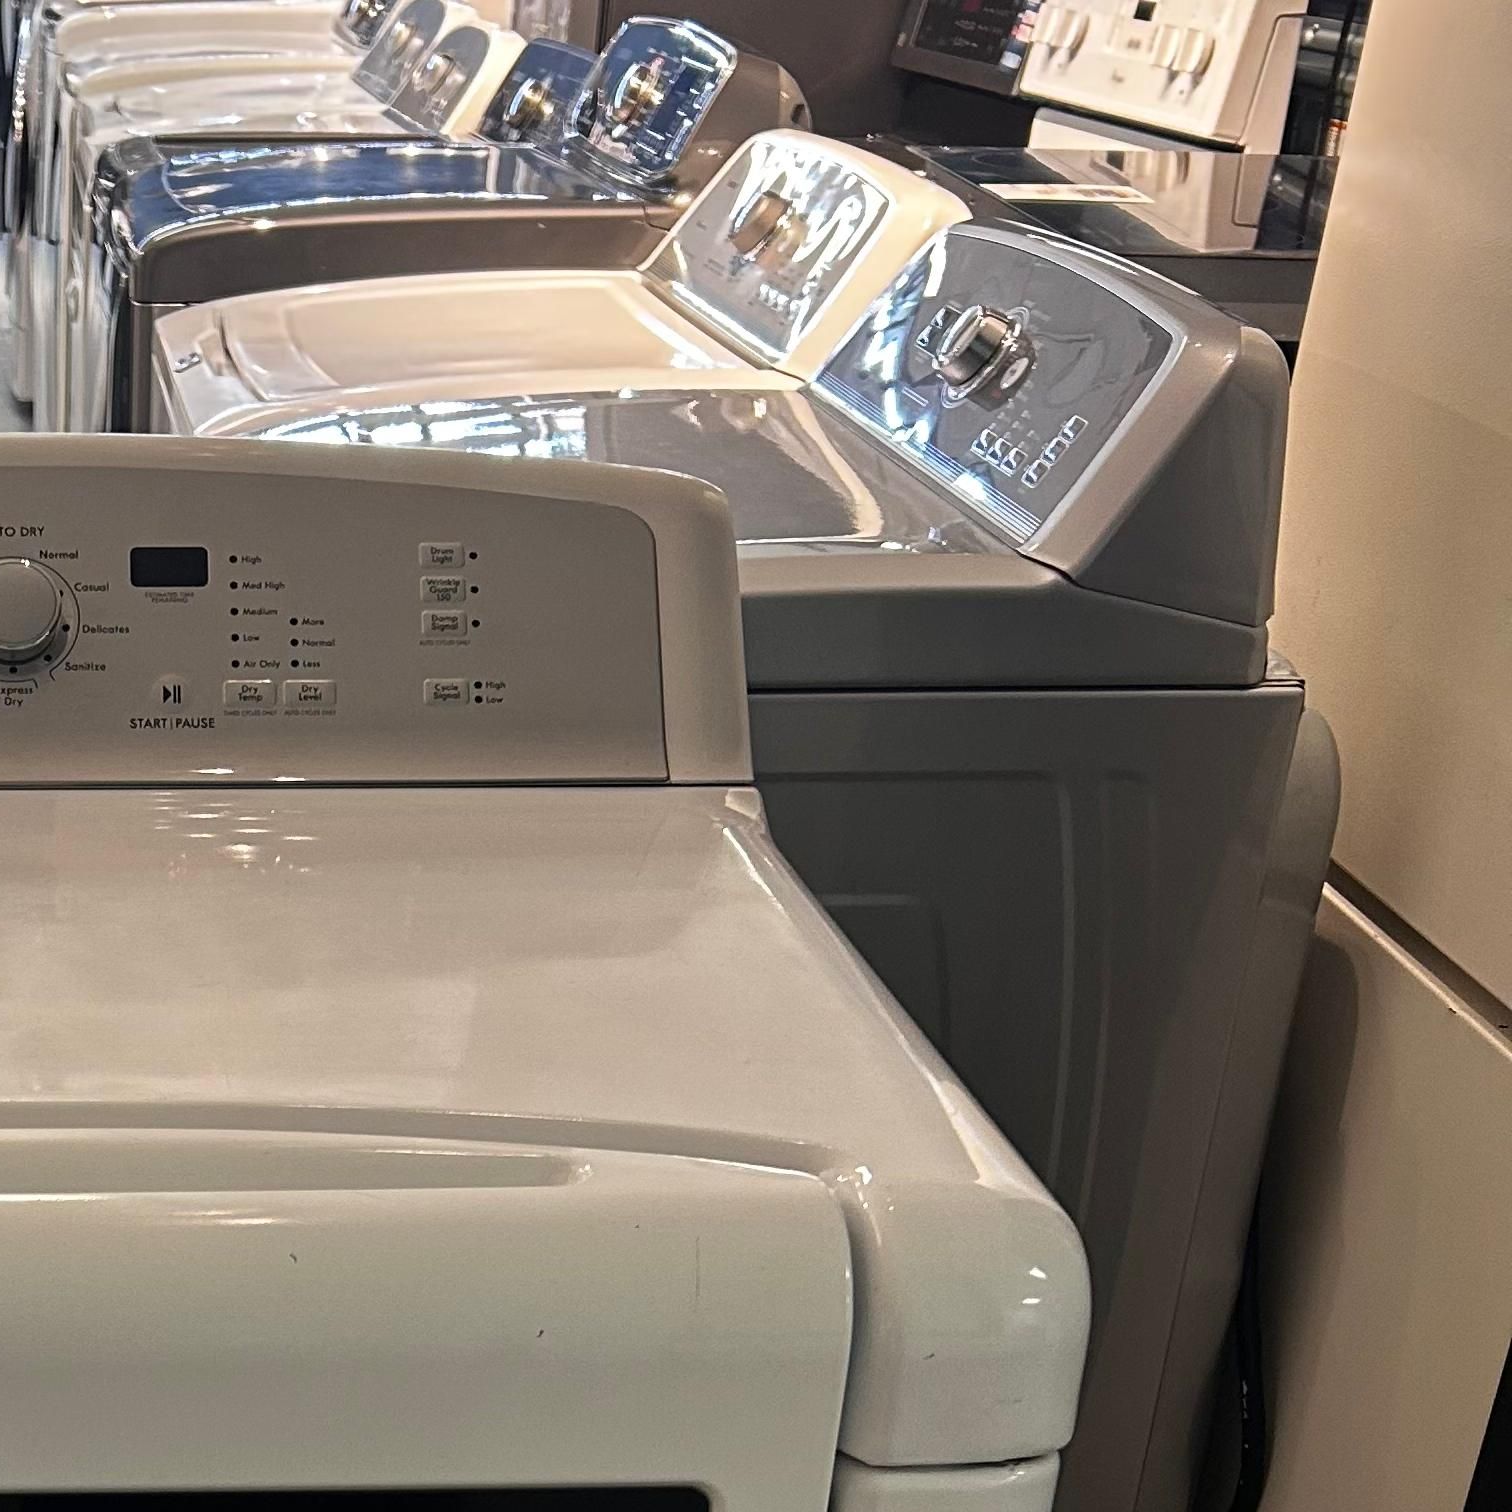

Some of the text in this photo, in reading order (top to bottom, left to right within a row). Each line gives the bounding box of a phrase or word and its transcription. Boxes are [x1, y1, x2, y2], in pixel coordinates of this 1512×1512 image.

[20, 526, 44, 538] DRY
[39, 550, 79, 560] Normal
[430, 547, 454, 555] Drum
[241, 555, 262, 565] High
[74, 582, 110, 592] Casual
[242, 581, 286, 592] Med High
[242, 607, 278, 616] Medium
[301, 617, 324, 626] More
[82, 624, 130, 634] Delicates
[243, 633, 260, 642] Low
[302, 638, 336, 647] Normal
[64, 662, 106, 672] Sanitize
[243, 660, 280, 670] Air Only
[302, 660, 320, 668] Less
[241, 684, 258, 694] Dry
[301, 684, 319, 694] Dry
[486, 682, 506, 690] High
[4, 696, 24, 707] Dry
[238, 692, 264, 703] Temp
[298, 692, 322, 702] Level
[486, 696, 504, 704] Low
[130, 718, 215, 729] START PAUSE
